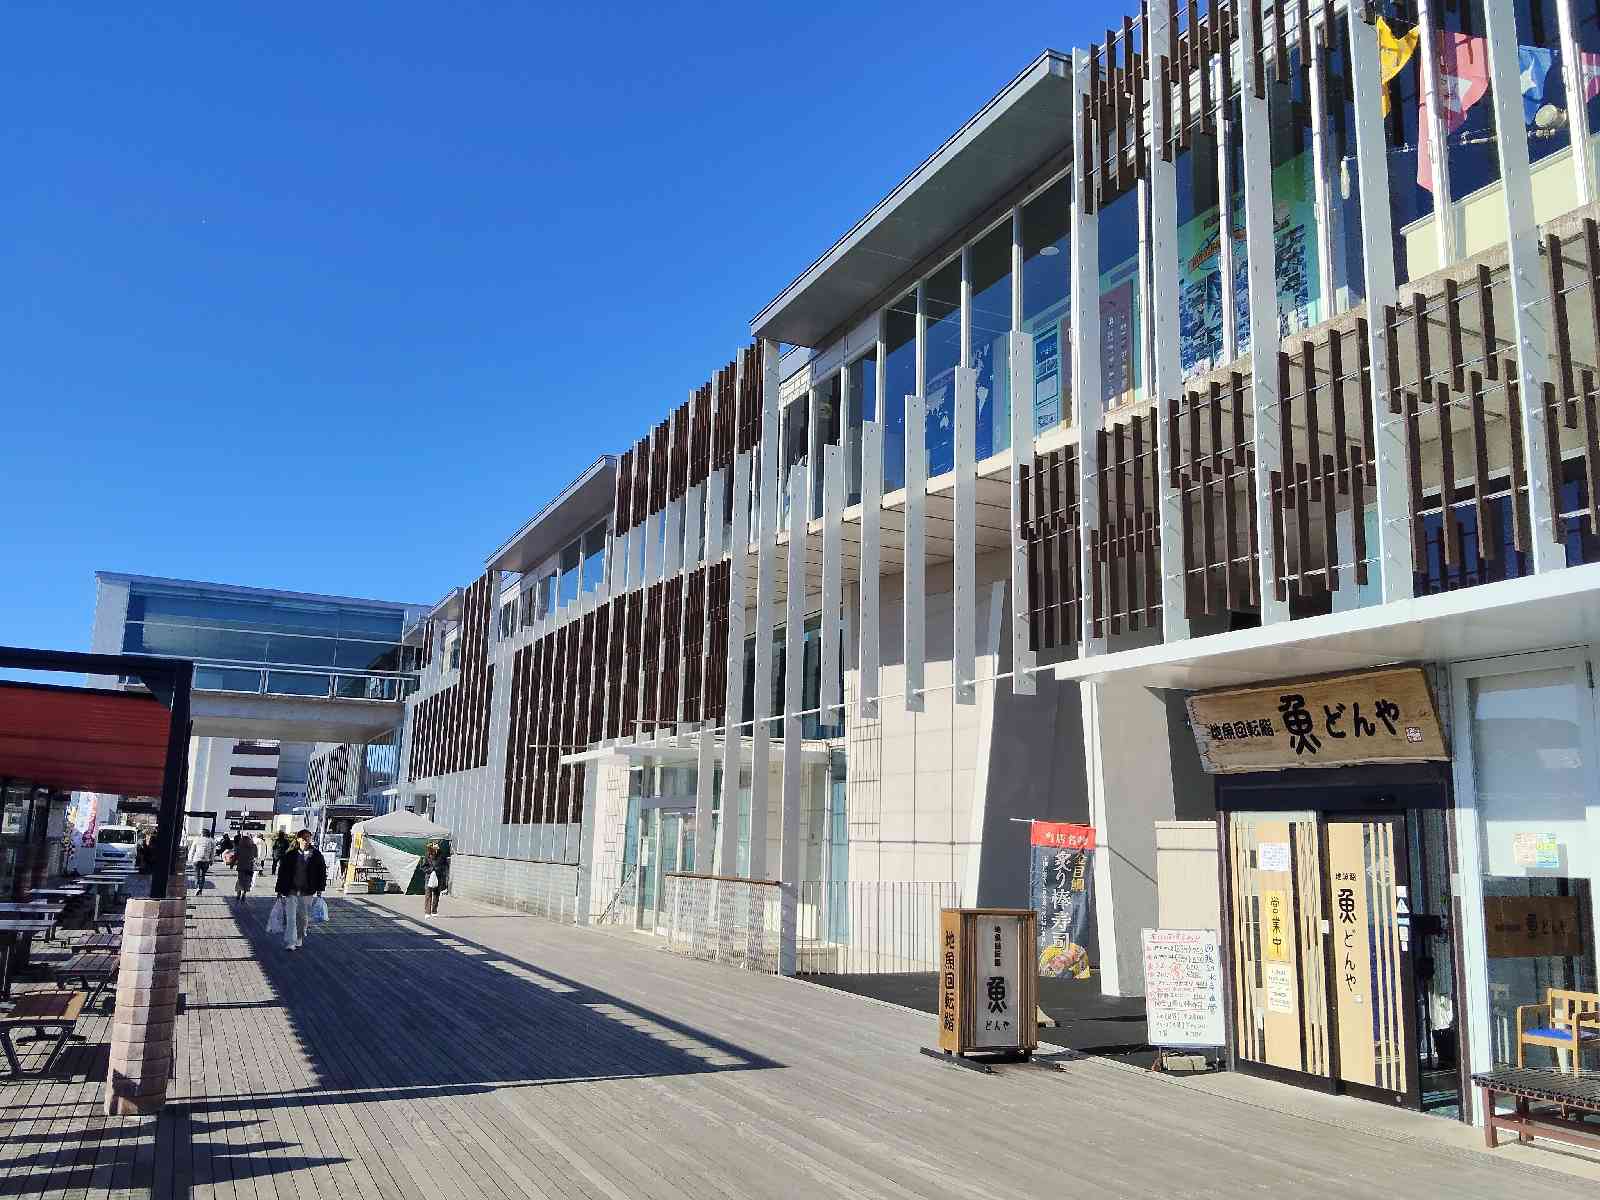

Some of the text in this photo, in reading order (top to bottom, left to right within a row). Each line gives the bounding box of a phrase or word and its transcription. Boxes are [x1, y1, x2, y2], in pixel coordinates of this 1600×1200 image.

[1051, 850, 1072, 953] 炙り棒寿司
[1270, 896, 1282, 953] 営業中
[1338, 888, 1358, 992] 魚どんや
